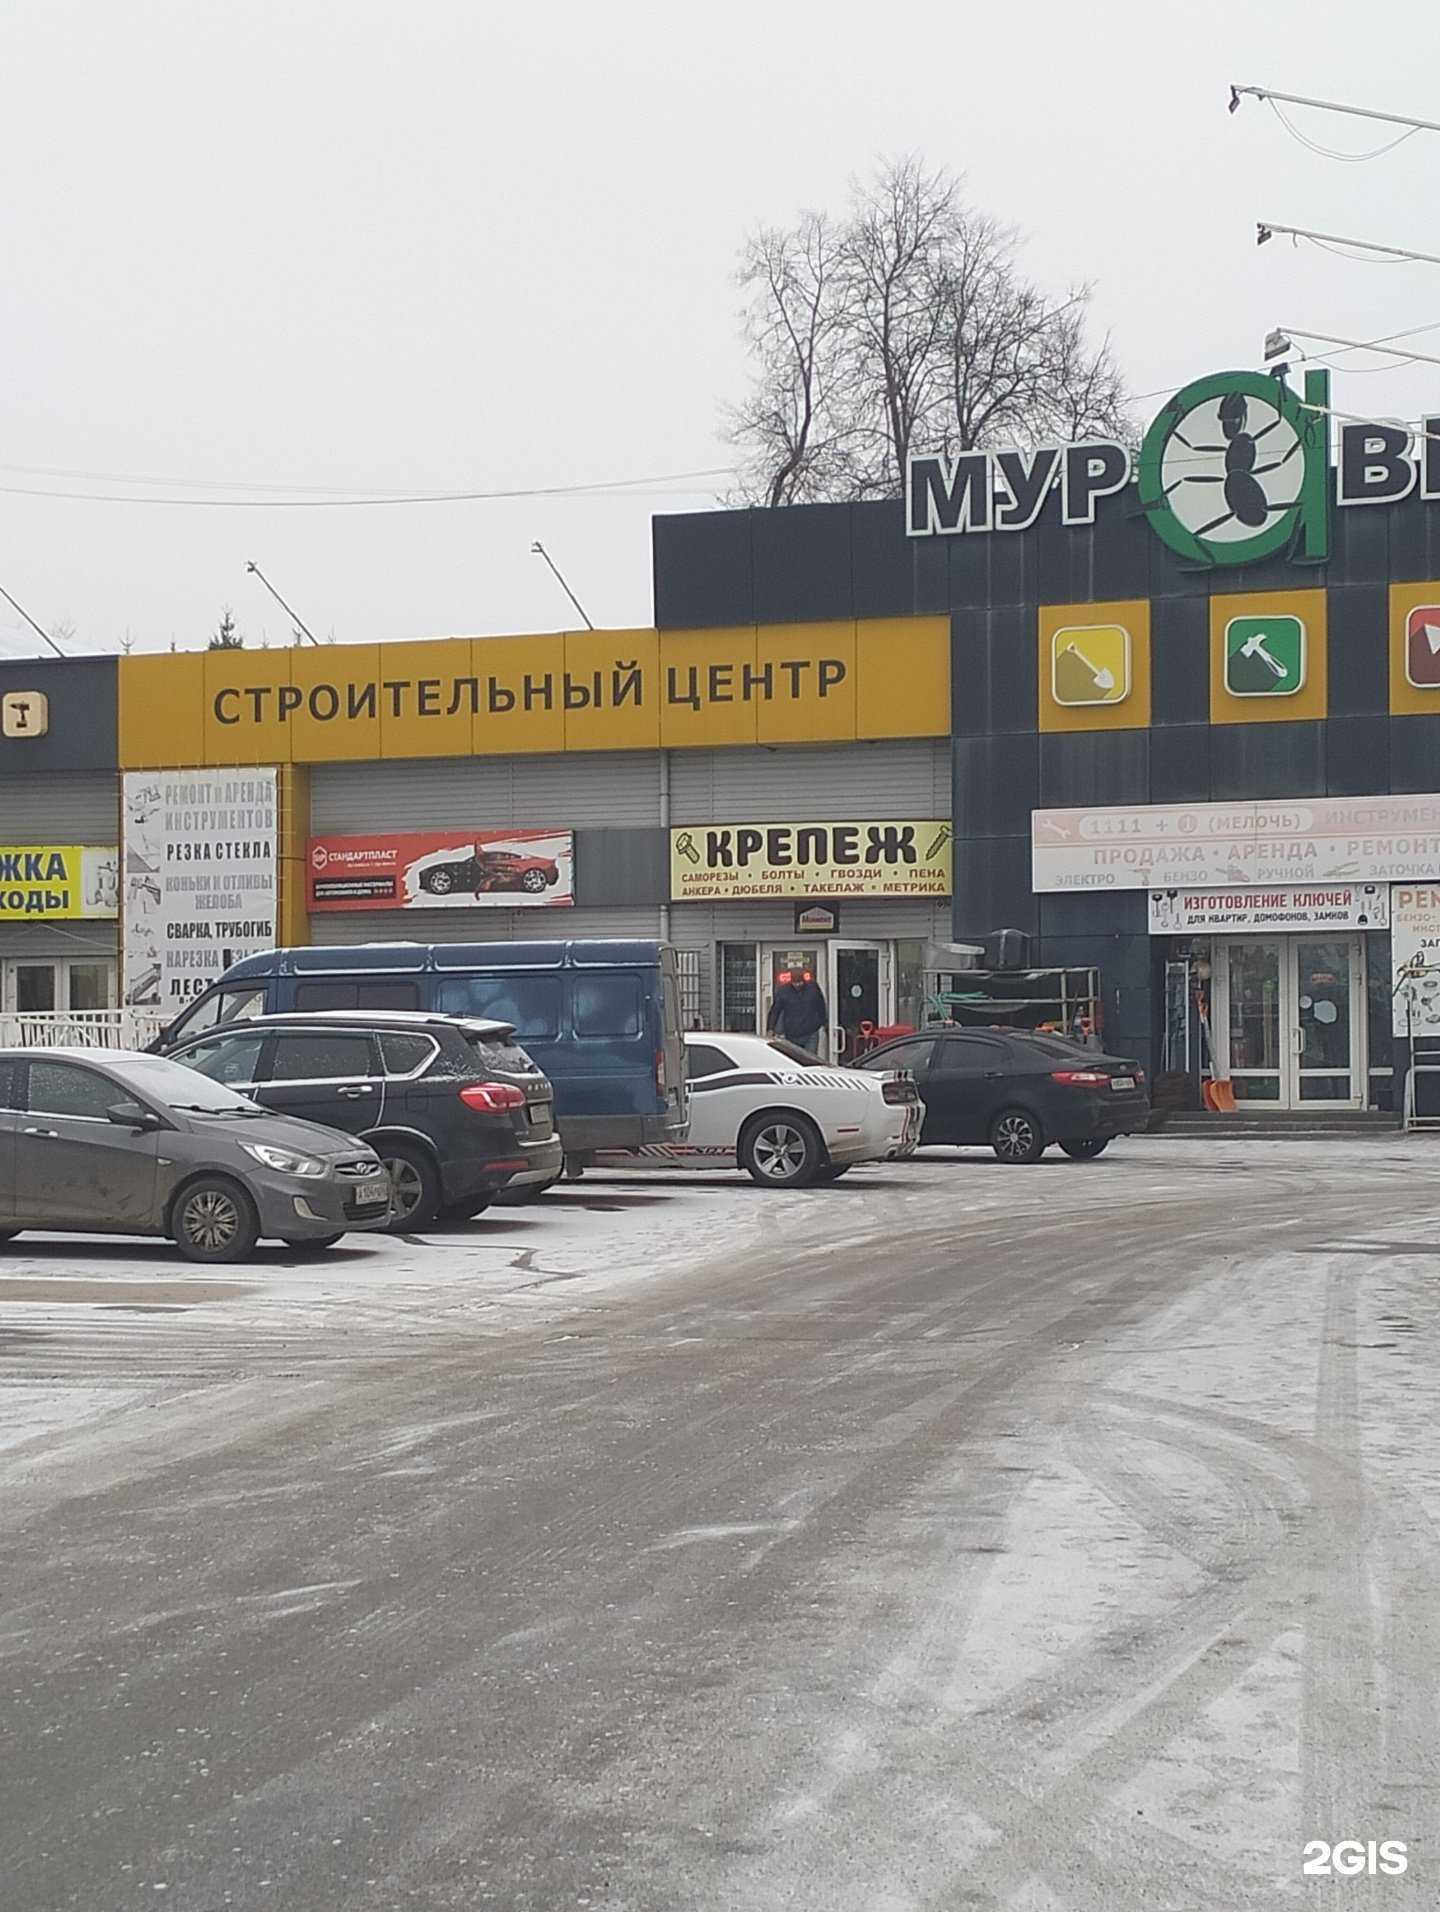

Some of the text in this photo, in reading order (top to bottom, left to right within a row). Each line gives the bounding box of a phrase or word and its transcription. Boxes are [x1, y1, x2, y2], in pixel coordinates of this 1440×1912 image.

[214, 659, 846, 725] СТРОИТЕЛЬНЫЙ ЦЕНТР
[165, 784, 212, 805] РЕМОНТ
[225, 781, 272, 806] АРЕНДА
[165, 809, 273, 831] ИНСТРУМЕНТОВ
[167, 841, 271, 861] РЕЗКА СТЕКЛА
[707, 827, 917, 867] КРЕПЕЖ
[1094, 838, 1440, 866] ПРОДАЖА АРЕНДА РЕМОНТ
[223, 874, 272, 890] ОТЛИВЫ
[681, 869, 945, 882] САМОРЕЗЫ БОЛТЫ ГВОЗДИ ПЕНА
[1055, 873, 1115, 887] ЭЛЕКТРО
[1163, 871, 1208, 882] БЕНЗО
[1257, 863, 1314, 879] РУЧНОЙ
[682, 883, 945, 896] АНКЕРА ДЮБЕЛЯ ТАКЕЛАЖ МЕТРИКА
[1184, 889, 1352, 910] ИЗГОТОВЛЕНИЕ КЛЮЧЕЙ
[195, 894, 242, 910] ЖЕЛОБА
[1187, 914, 1206, 924] ДЛЯ
[1314, 911, 1349, 921] ЗАМКОВ
[167, 920, 272, 940] СВАРКА, ТРУБОГИБ
[166, 950, 219, 968] НАРЕЗКА
